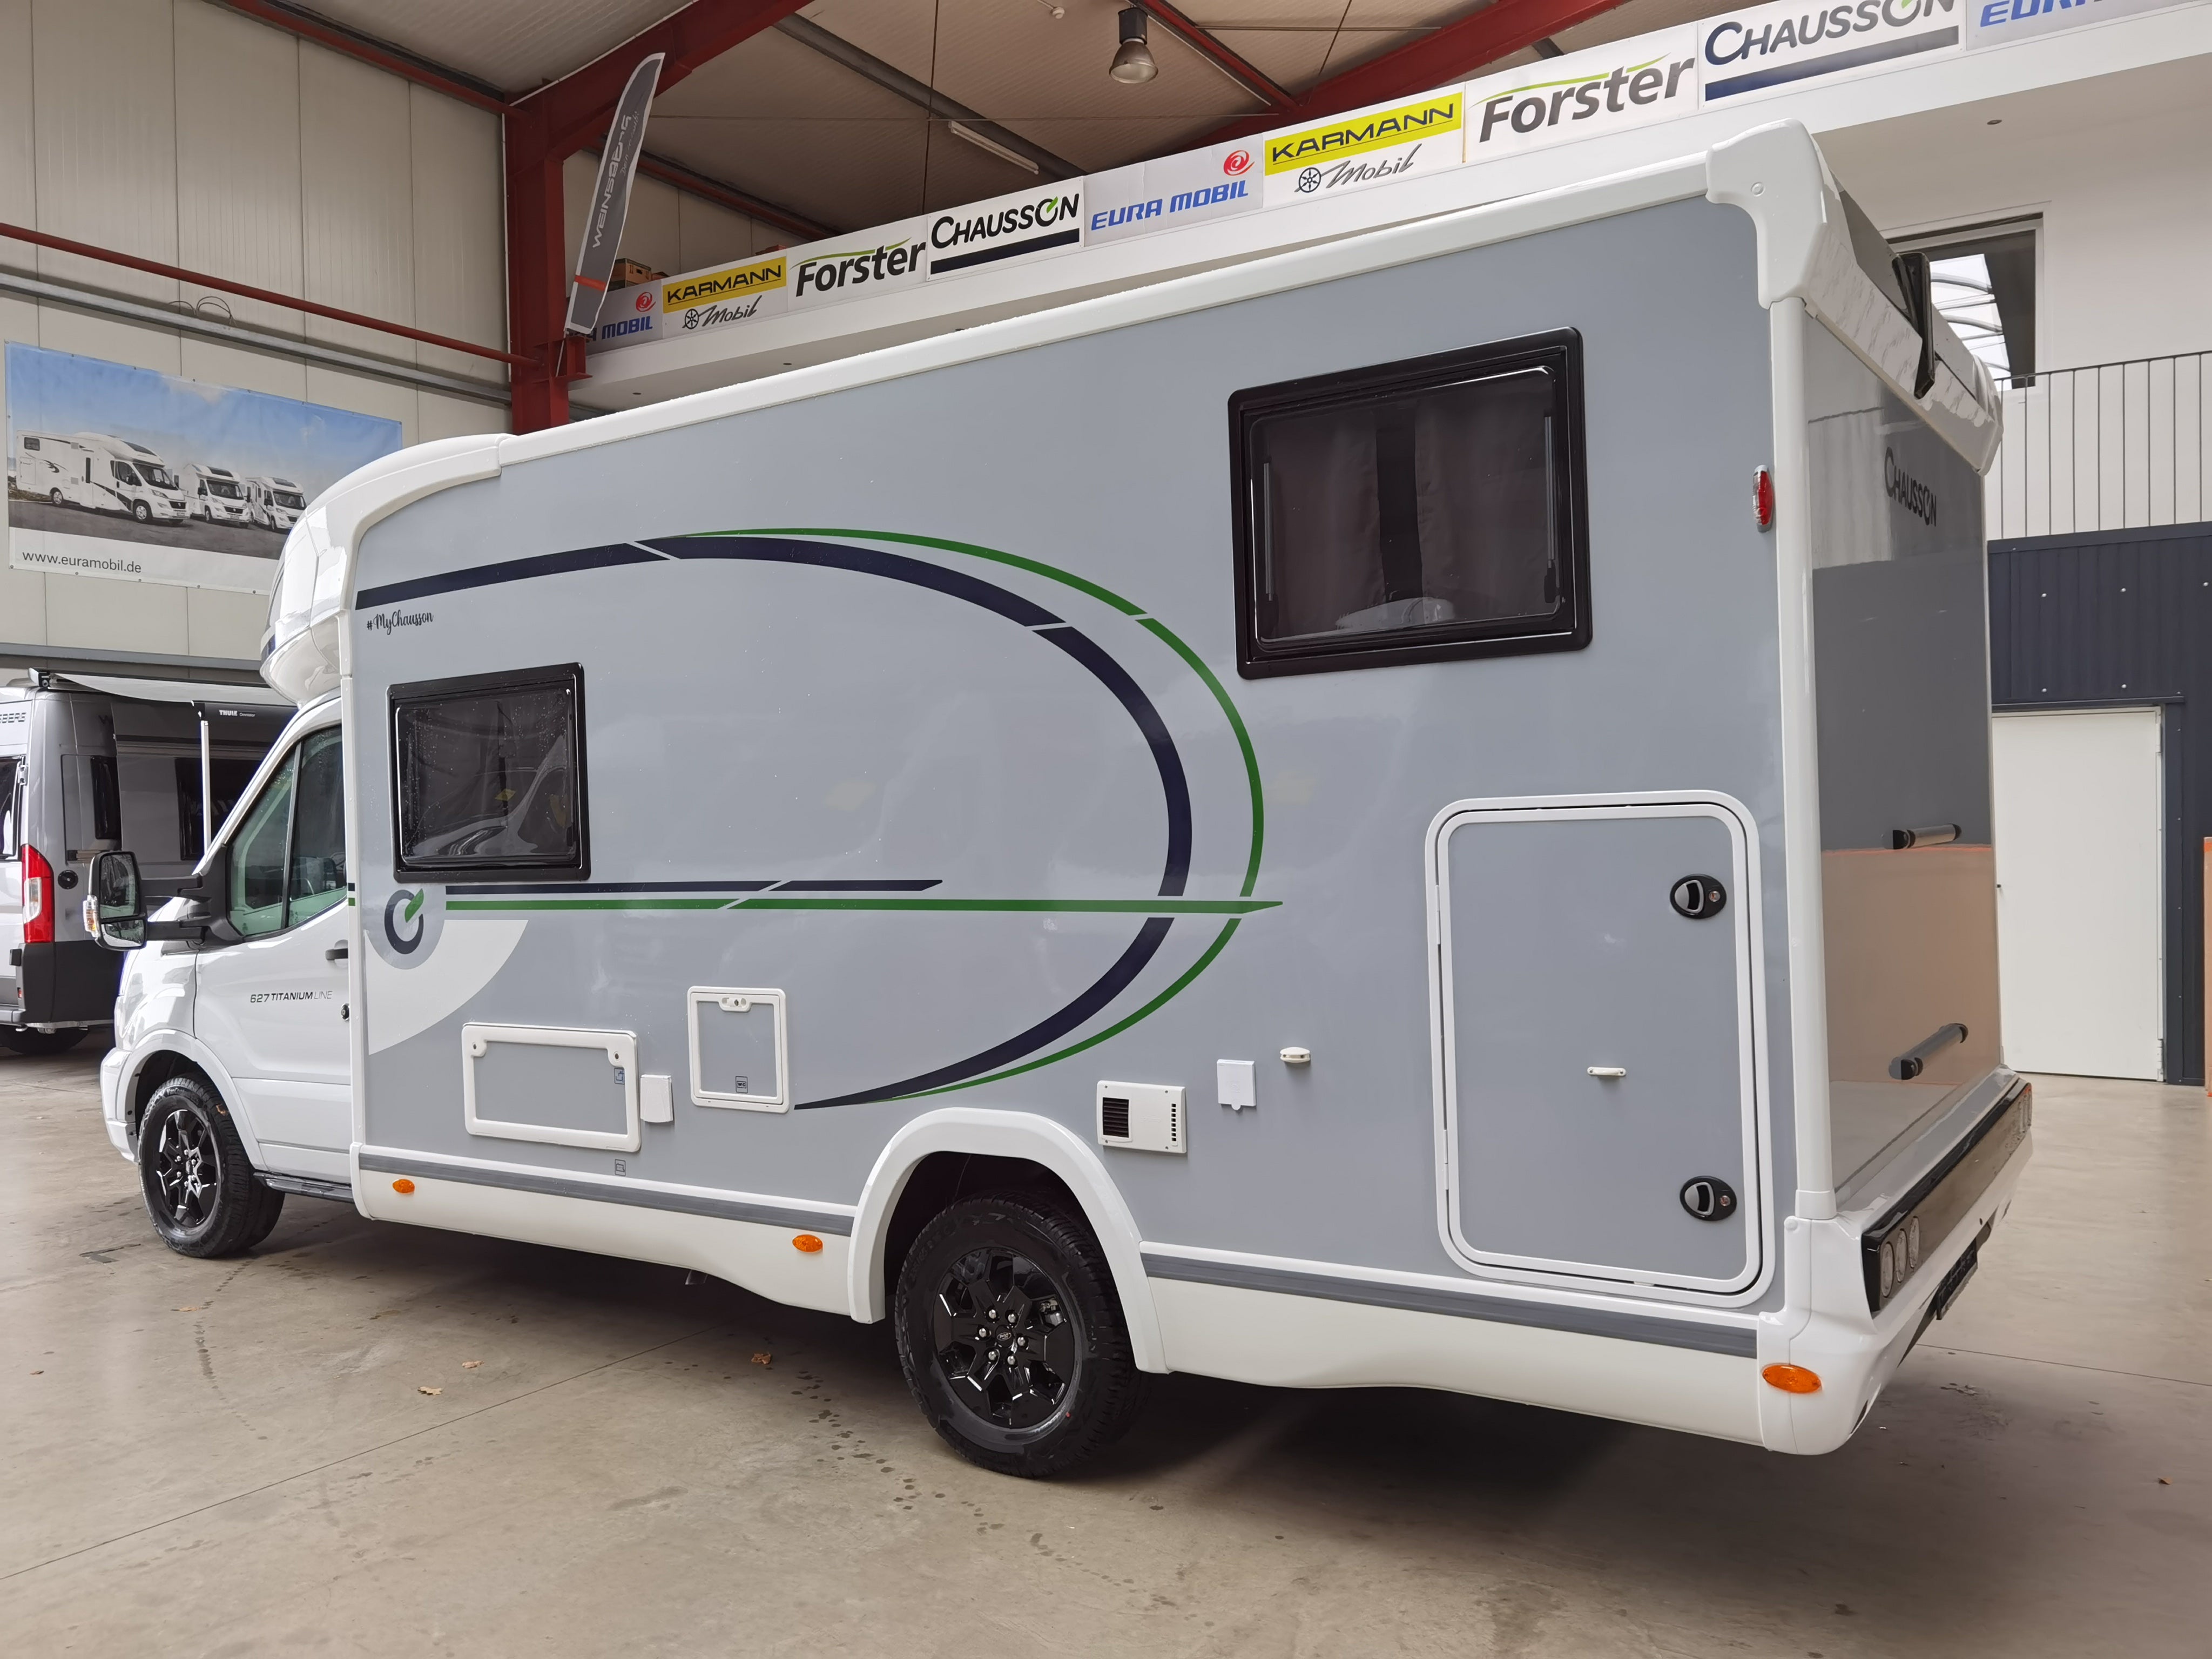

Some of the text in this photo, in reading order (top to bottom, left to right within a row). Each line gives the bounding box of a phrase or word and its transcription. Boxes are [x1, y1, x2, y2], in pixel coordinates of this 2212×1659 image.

[1980, 0, 2102, 27] EUR
[1479, 57, 1695, 143] Forster
[1272, 103, 1453, 163] KARMANN
[1320, 143, 1422, 188] Mobil
[931, 193, 1079, 248] CHAUSSON
[1091, 180, 1249, 231] EURA MOBIL
[667, 265, 781, 303] KARMANN
[796, 242, 926, 297] Forster
[602, 316, 653, 339] MOBIL
[699, 295, 762, 327] Mobil
[1884, 447, 1937, 527] CHAUSSON
[22, 552, 141, 573] www.euramobil.de
[367, 609, 434, 635] #MyChausson
[0, 712, 26, 724] BERG
[250, 994, 269, 1003] 627
